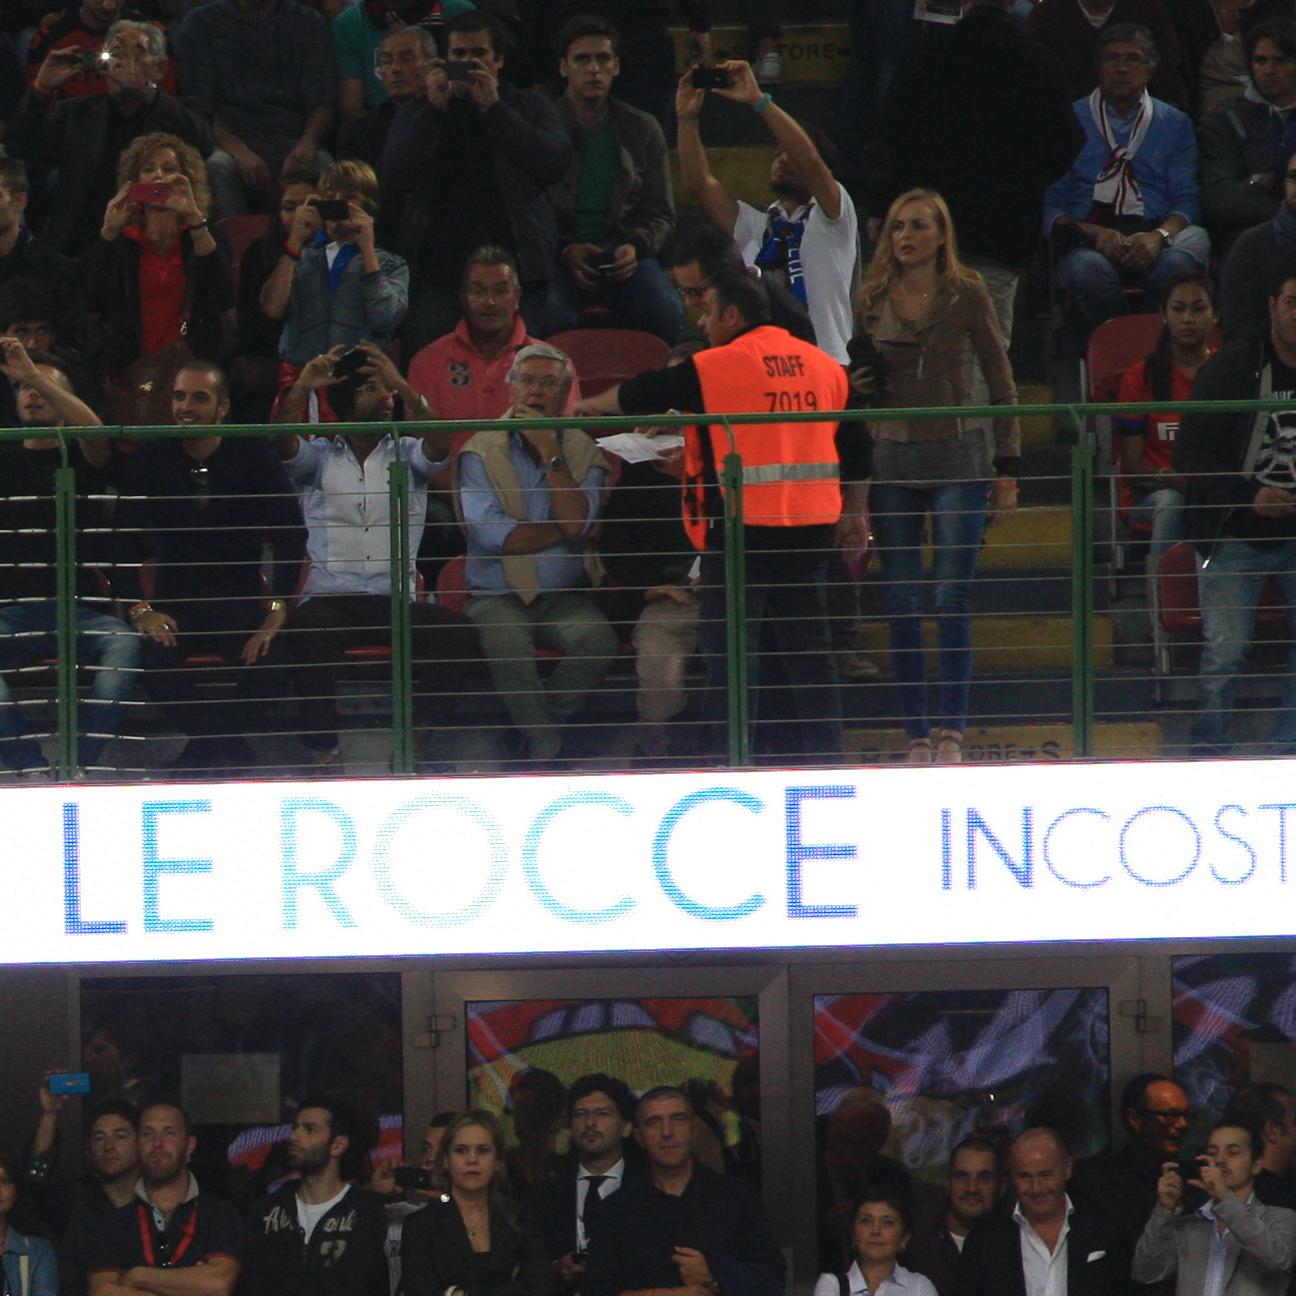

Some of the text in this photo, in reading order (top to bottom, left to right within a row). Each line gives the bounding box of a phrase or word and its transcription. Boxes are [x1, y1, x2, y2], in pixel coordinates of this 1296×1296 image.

[763, 355, 805, 378] STAFF
[764, 390, 817, 412] 7019
[62, 799, 215, 935] LE
[281, 784, 859, 931] ROCCE
